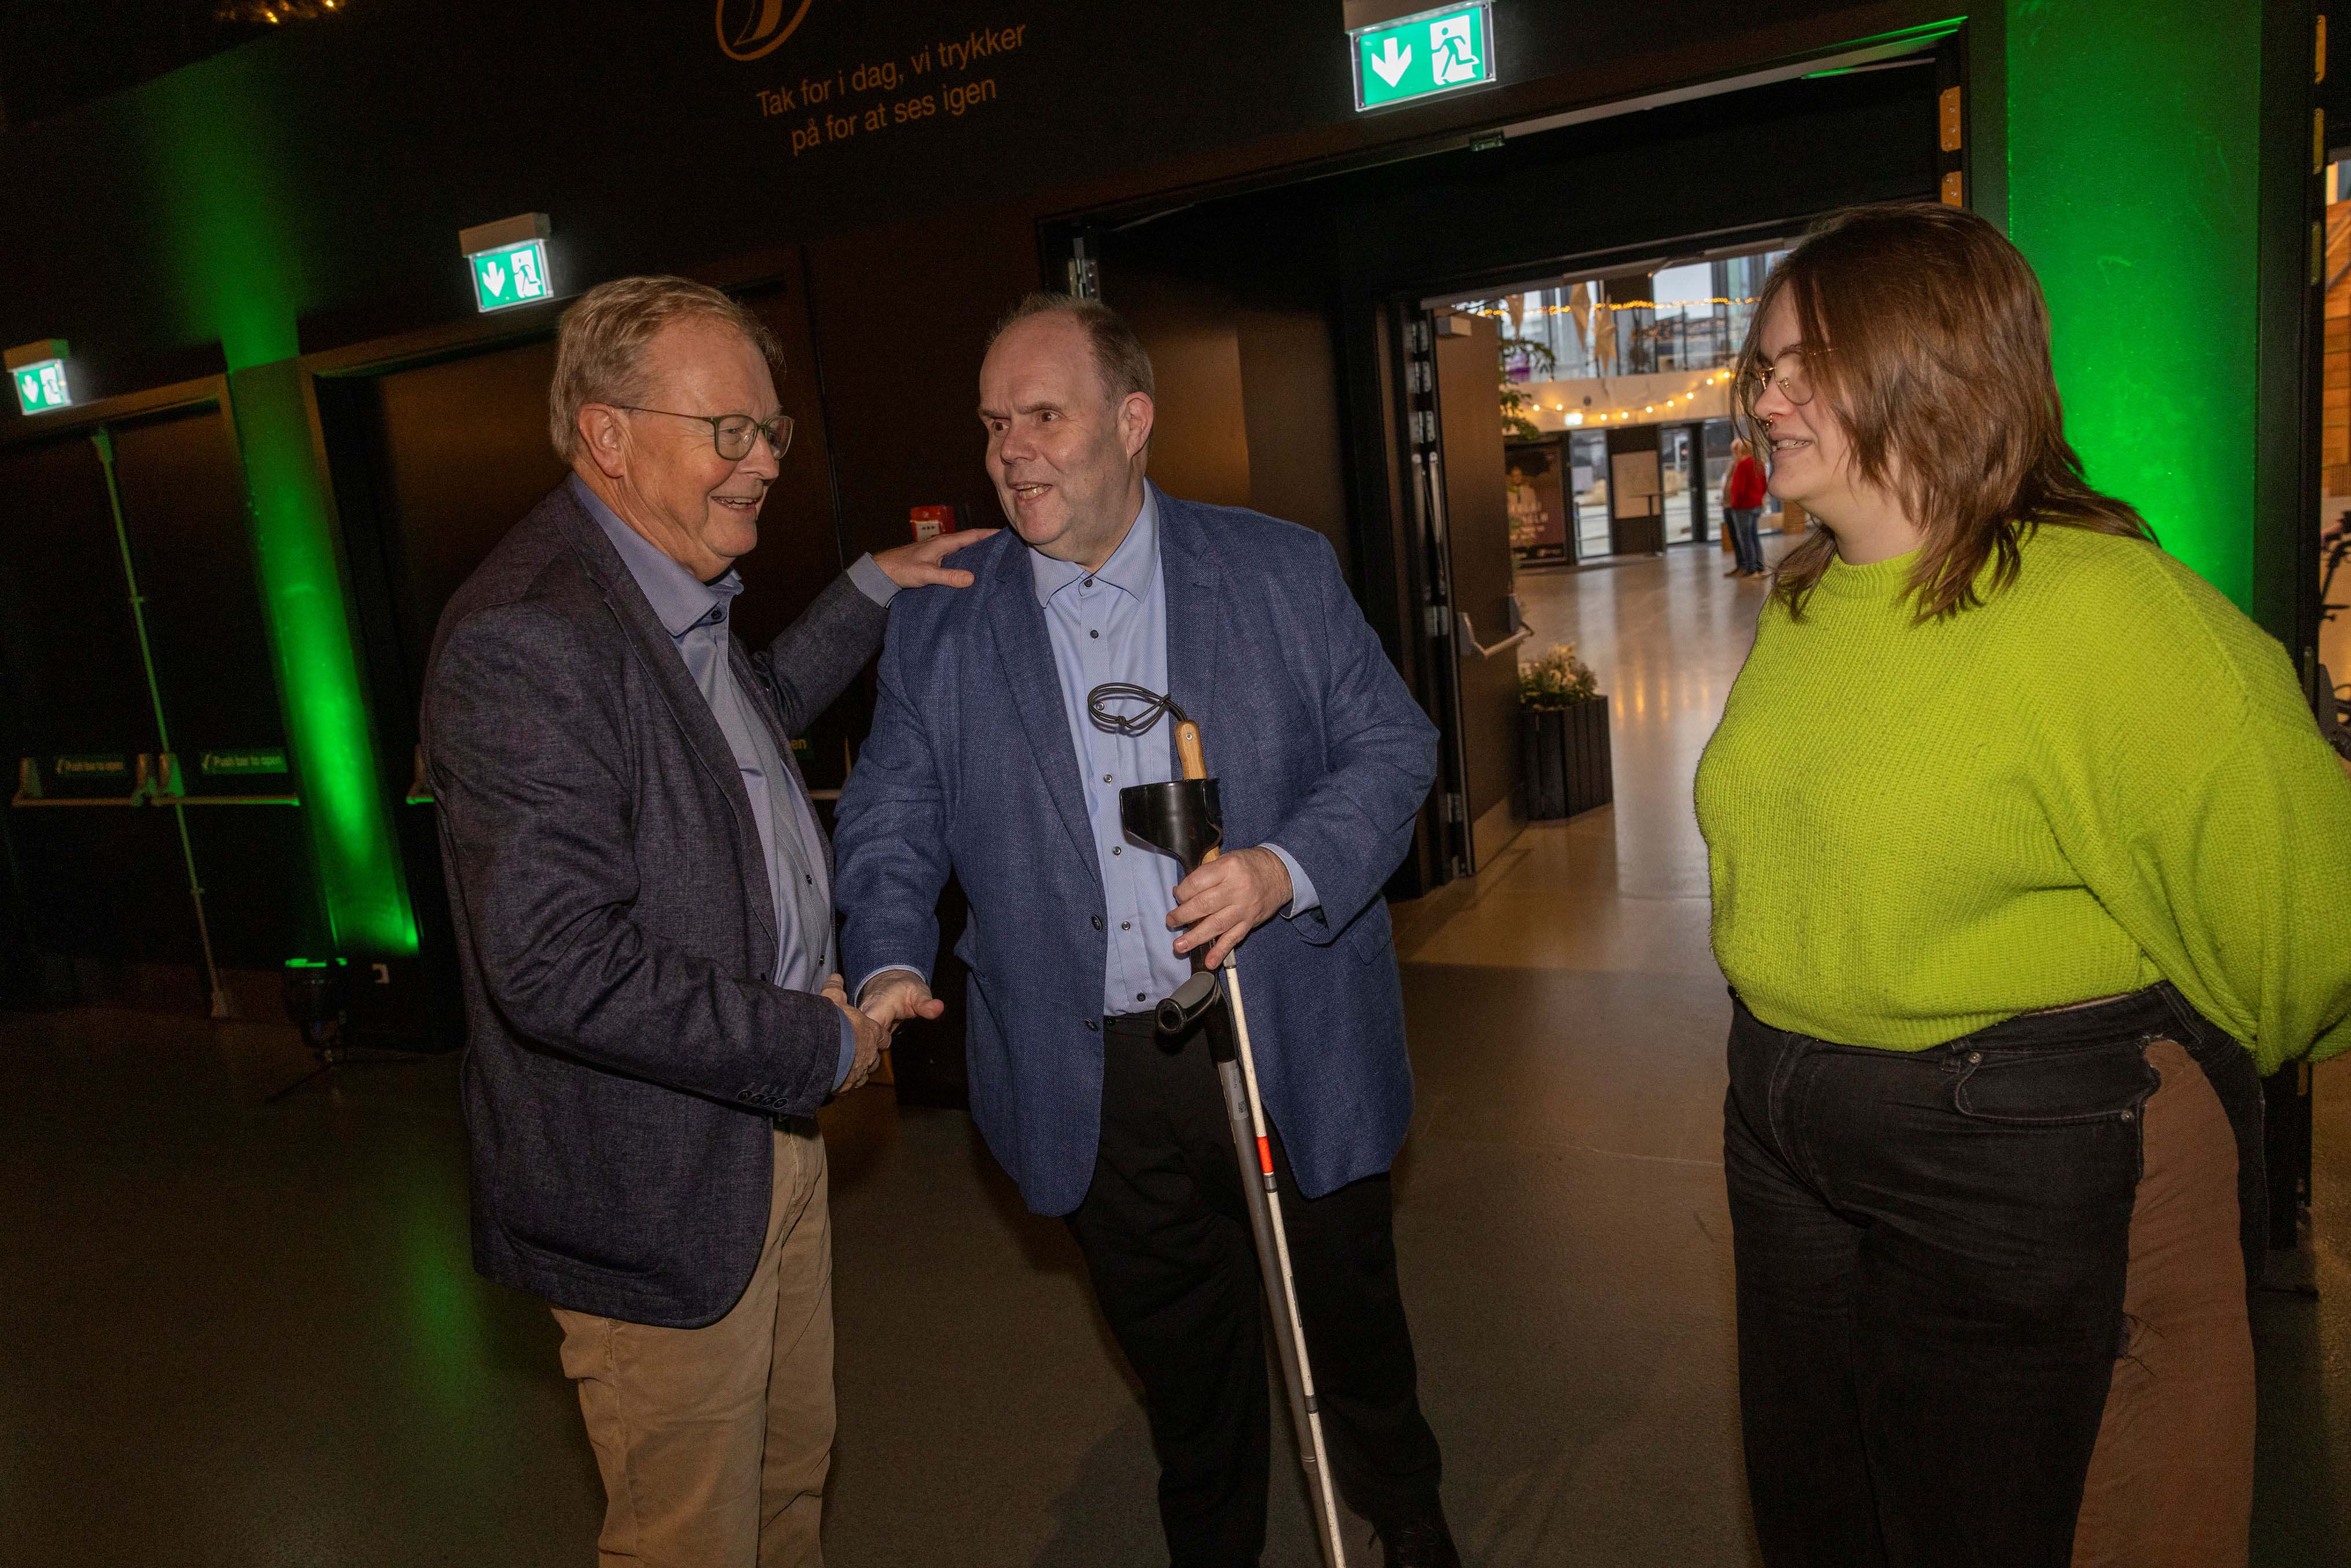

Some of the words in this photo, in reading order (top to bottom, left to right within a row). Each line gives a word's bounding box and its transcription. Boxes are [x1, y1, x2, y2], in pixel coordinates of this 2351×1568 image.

[756, 86, 796, 117] Tak
[800, 79, 832, 107] for
[838, 70, 845, 96] i
[852, 62, 904, 92] dag,
[911, 45, 932, 75] vi
[938, 24, 1027, 71] trykker
[792, 118, 822, 157] på
[825, 114, 858, 142] for
[865, 102, 888, 132] at
[893, 94, 936, 124] ses
[942, 79, 997, 117] igen
